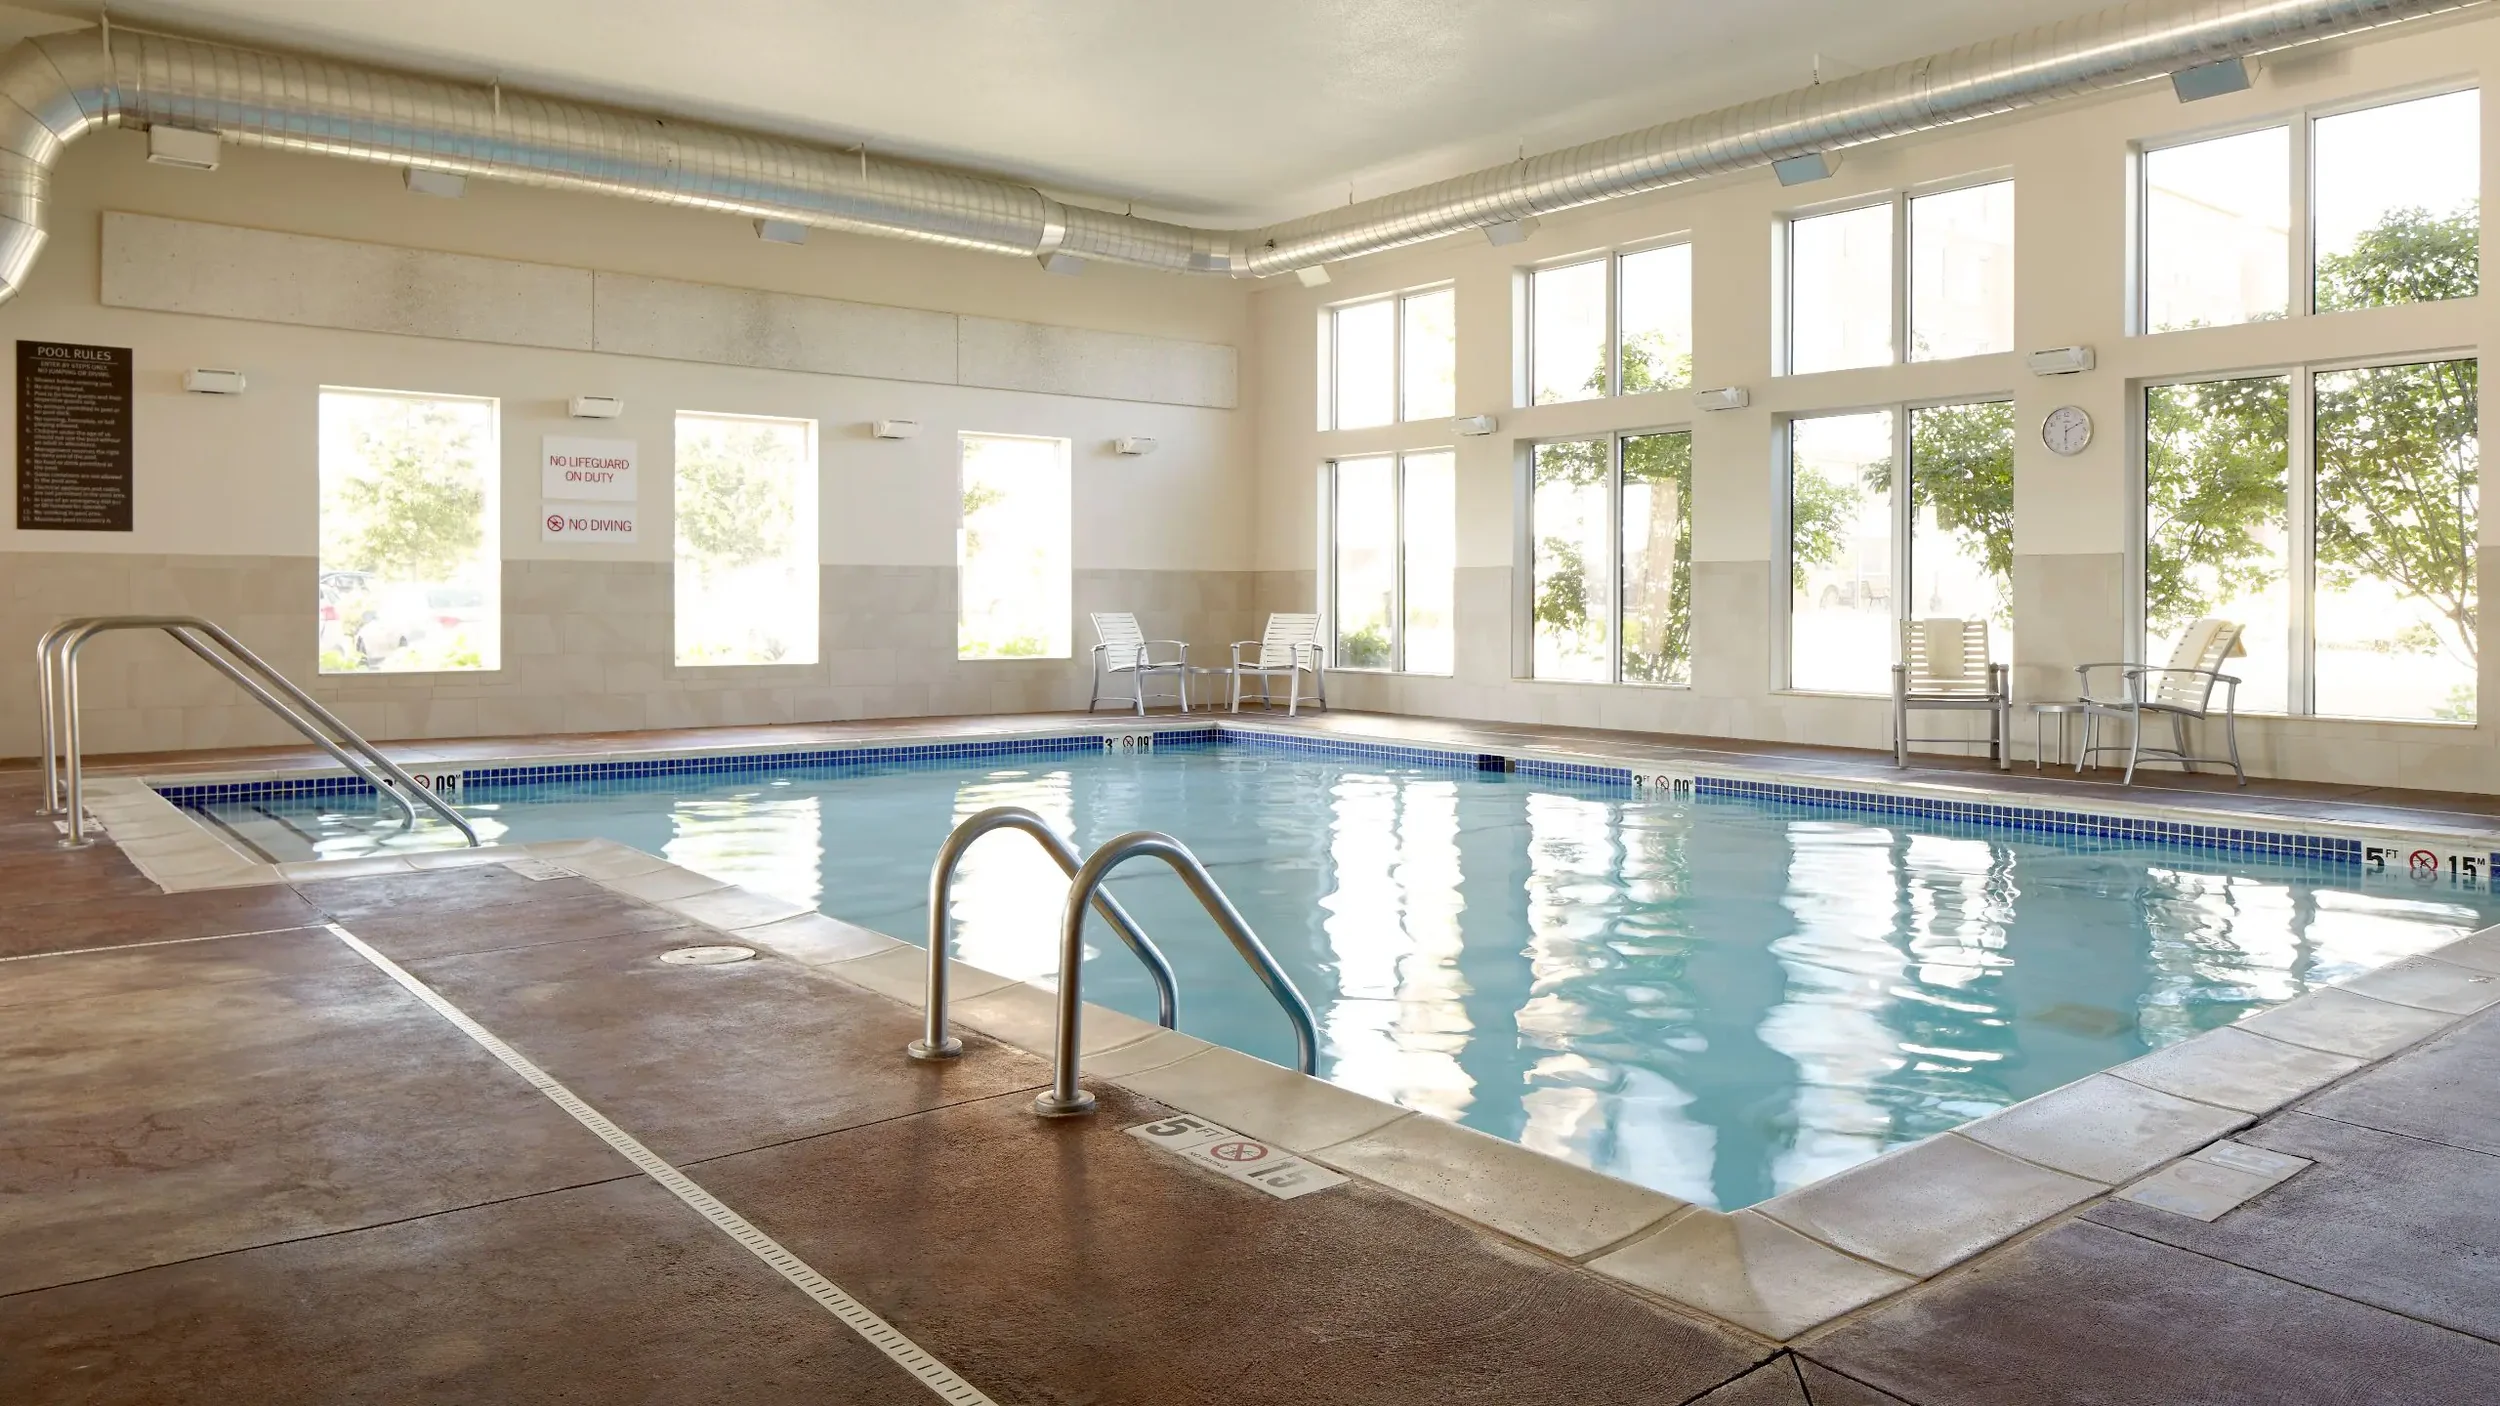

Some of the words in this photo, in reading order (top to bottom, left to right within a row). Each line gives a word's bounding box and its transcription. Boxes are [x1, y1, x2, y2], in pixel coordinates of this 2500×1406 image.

[37, 346, 71, 358] POOL
[74, 348, 112, 361] RULES
[550, 455, 567, 467] NO
[569, 456, 630, 470] LIFEGUARD
[565, 471, 582, 482] ON
[584, 472, 614, 483] DUTY
[568, 518, 588, 531] NO
[590, 519, 632, 532] DIVING
